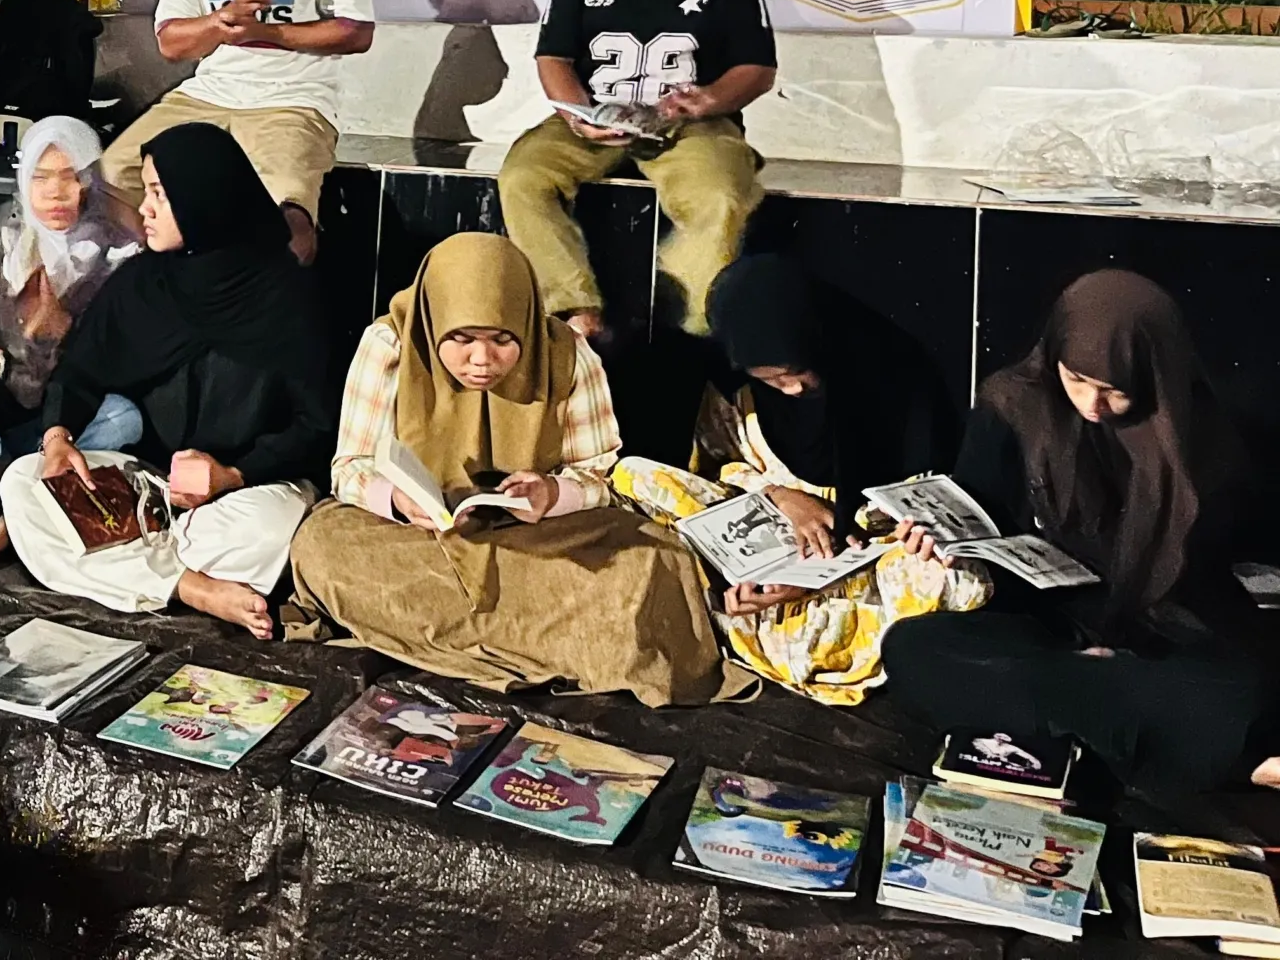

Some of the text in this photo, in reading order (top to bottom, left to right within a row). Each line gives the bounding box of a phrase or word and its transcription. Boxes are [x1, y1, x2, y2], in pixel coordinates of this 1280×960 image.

[588, 31, 700, 106] 28
[507, 776, 563, 795] Takut
[507, 794, 550, 811] Tumi
[702, 841, 754, 859] DUDU
